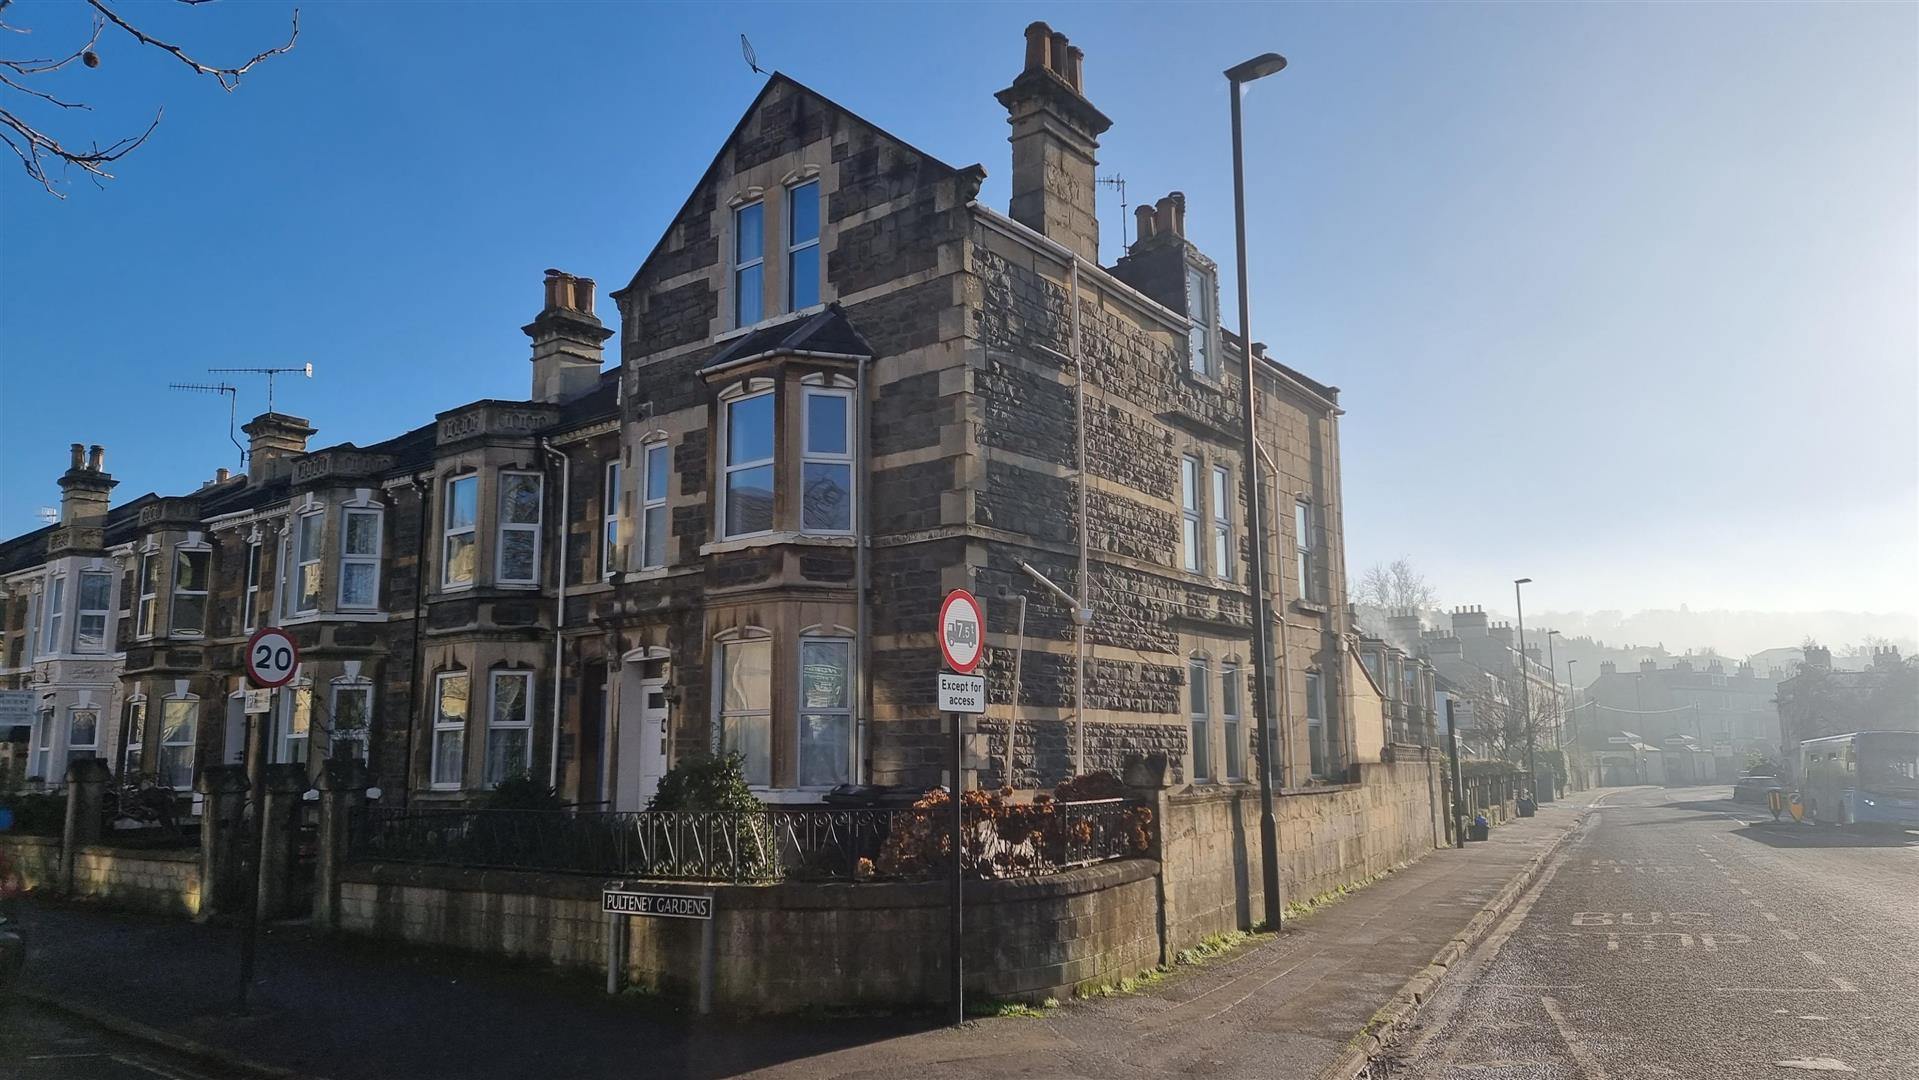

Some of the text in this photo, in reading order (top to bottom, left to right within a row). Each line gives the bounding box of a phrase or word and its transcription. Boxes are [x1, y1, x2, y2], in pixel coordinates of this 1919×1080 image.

[255, 644, 292, 671] 20
[941, 679, 982, 694] Except for
[949, 695, 975, 706] access
[607, 894, 707, 916] PULTENEY GARDENS
[1570, 911, 1714, 926] BUS
